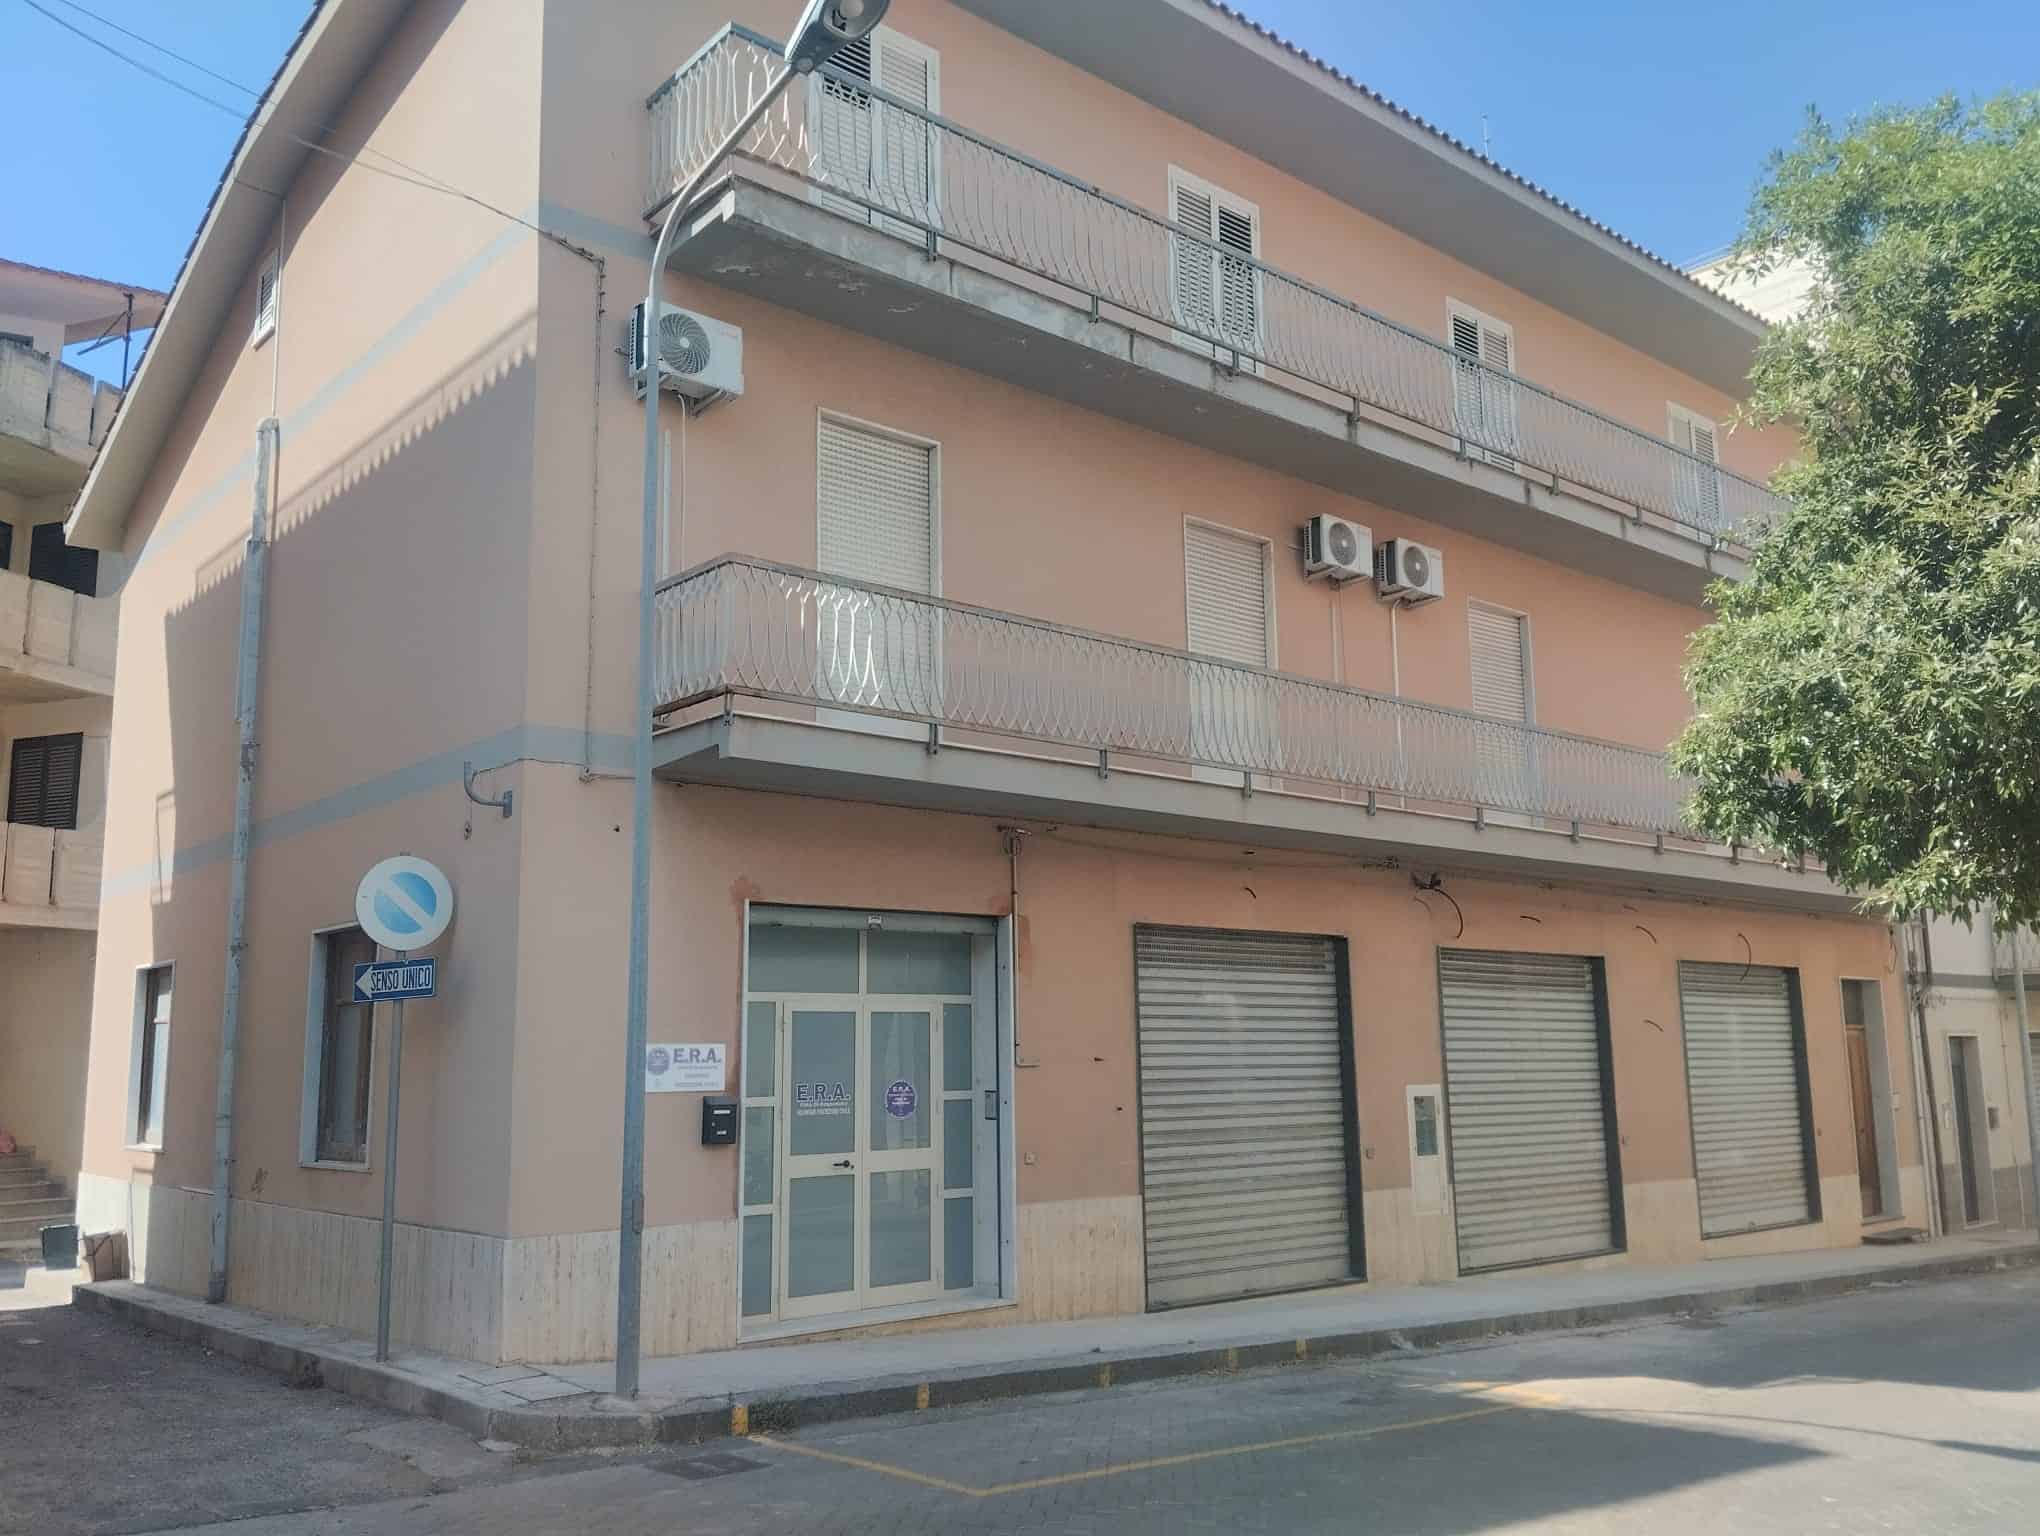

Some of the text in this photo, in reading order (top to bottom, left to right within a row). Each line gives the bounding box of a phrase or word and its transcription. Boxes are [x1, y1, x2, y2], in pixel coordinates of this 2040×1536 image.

[370, 967, 430, 992] SENSO UNICO
[673, 1047, 721, 1064] E.R.A.
[796, 1083, 850, 1102] E.R.A.
